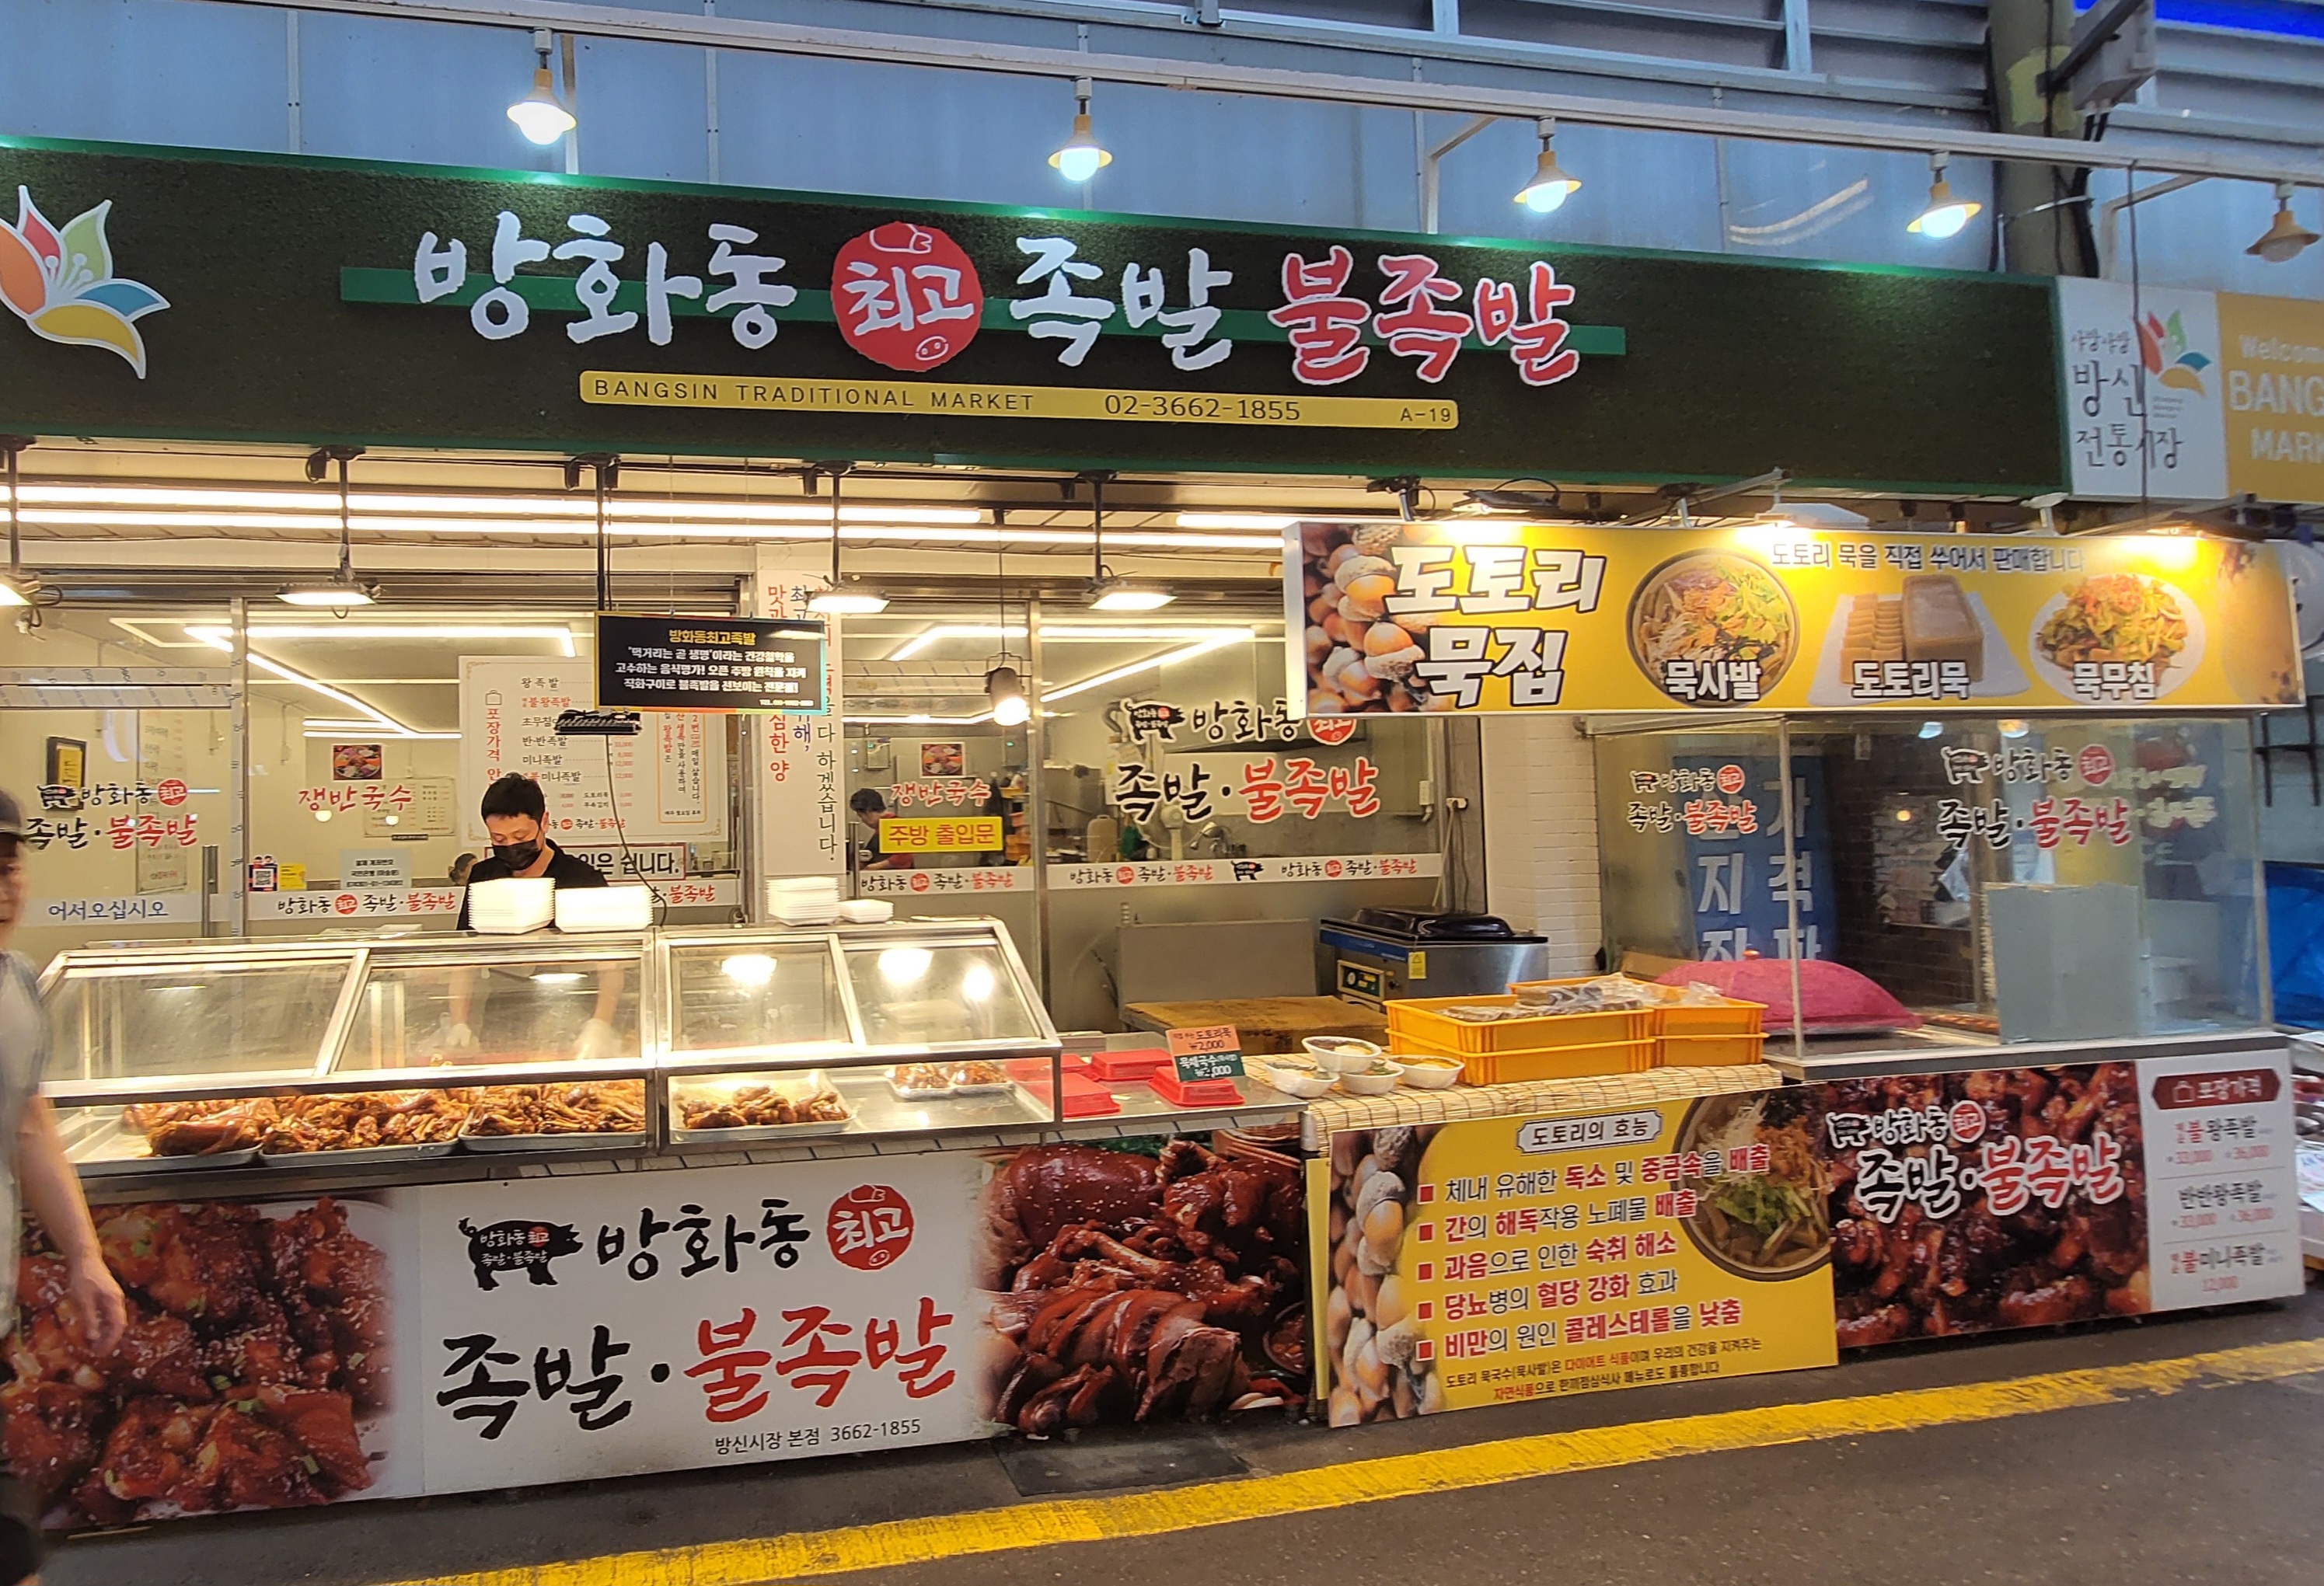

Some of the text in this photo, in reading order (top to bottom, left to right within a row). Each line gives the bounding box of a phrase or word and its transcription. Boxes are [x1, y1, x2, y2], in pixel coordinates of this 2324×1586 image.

[415, 211, 1579, 386] 방화동 최고 족발 불족발
[594, 378, 1035, 412] BANGSIN TRADITIONAL MARKET
[2072, 360, 2147, 417] 방신
[2228, 370, 2324, 417] BANG
[1104, 393, 1300, 422] 02-3662-1855
[1400, 405, 1451, 424] A-19
[2075, 424, 2185, 469] 전통시장
[1772, 542, 1830, 568] 도토리
[1837, 543, 1877, 569] 묵을
[1884, 544, 1923, 570] 직접
[1993, 547, 2085, 573] 판매합니다
[1383, 543, 1607, 615] 도토리
[668, 629, 756, 646] 방화동최고족발
[615, 662, 658, 674] 고수하는
[707, 665, 729, 677] 오픈
[731, 666, 752, 678] 주방
[623, 678, 676, 691] 직화구이로
[679, 679, 720, 692] 불족발을
[721, 680, 762, 693] 선보이는
[1415, 626, 1569, 709] 묵집
[1664, 660, 1761, 702] 묵사발
[1852, 660, 1969, 699] 도토리묵
[2073, 661, 2158, 701] 묵무침
[817, 723, 836, 743] 다
[1193, 700, 1302, 740] 방화동
[486, 708, 502, 783] 포장가격 안
[522, 755, 563, 766] 미니족발
[770, 760, 790, 782] 양
[1993, 747, 2075, 783] 방화동
[82, 781, 153, 806] 방화동
[298, 783, 412, 812] 쟁반국수
[816, 750, 838, 861] 하겠습니다.
[892, 778, 991, 807] 쟁반국수
[888, 824, 996, 846] 주방 출입문
[619, 851, 680, 875] 쉽니다.
[48, 898, 169, 921] 어서오십시오
[1532, 1117, 1649, 1146] 도토리의 효능
[1446, 1142, 1770, 1203] 체내 유해한 독소 및 중금속을 배출
[1445, 1188, 1697, 1243] 간의 해독작용 노폐물 배출
[480, 1229, 526, 1247] 방화동
[598, 1197, 910, 1281] 방화동 최고
[1444, 1230, 1677, 1281] 과음으로 인한 숙취 해소
[1445, 1268, 1678, 1321] 당뇨병의 혈당 강화 효과
[1445, 1298, 1741, 1358] 비만의 원인 콜레스테롤을 낮춤
[1446, 1370, 1477, 1389] 도토리
[1565, 1354, 1606, 1372] 다이어트
[1609, 1349, 1650, 1366] 식품이며
[1654, 1345, 1684, 1361] 우리의
[1687, 1341, 1718, 1358] 건강을
[1721, 1337, 1762, 1354] 지켜주는
[1493, 1381, 1556, 1401] 자연식품으로
[714, 1417, 921, 1455] 방신시장 본점 3662-1855
